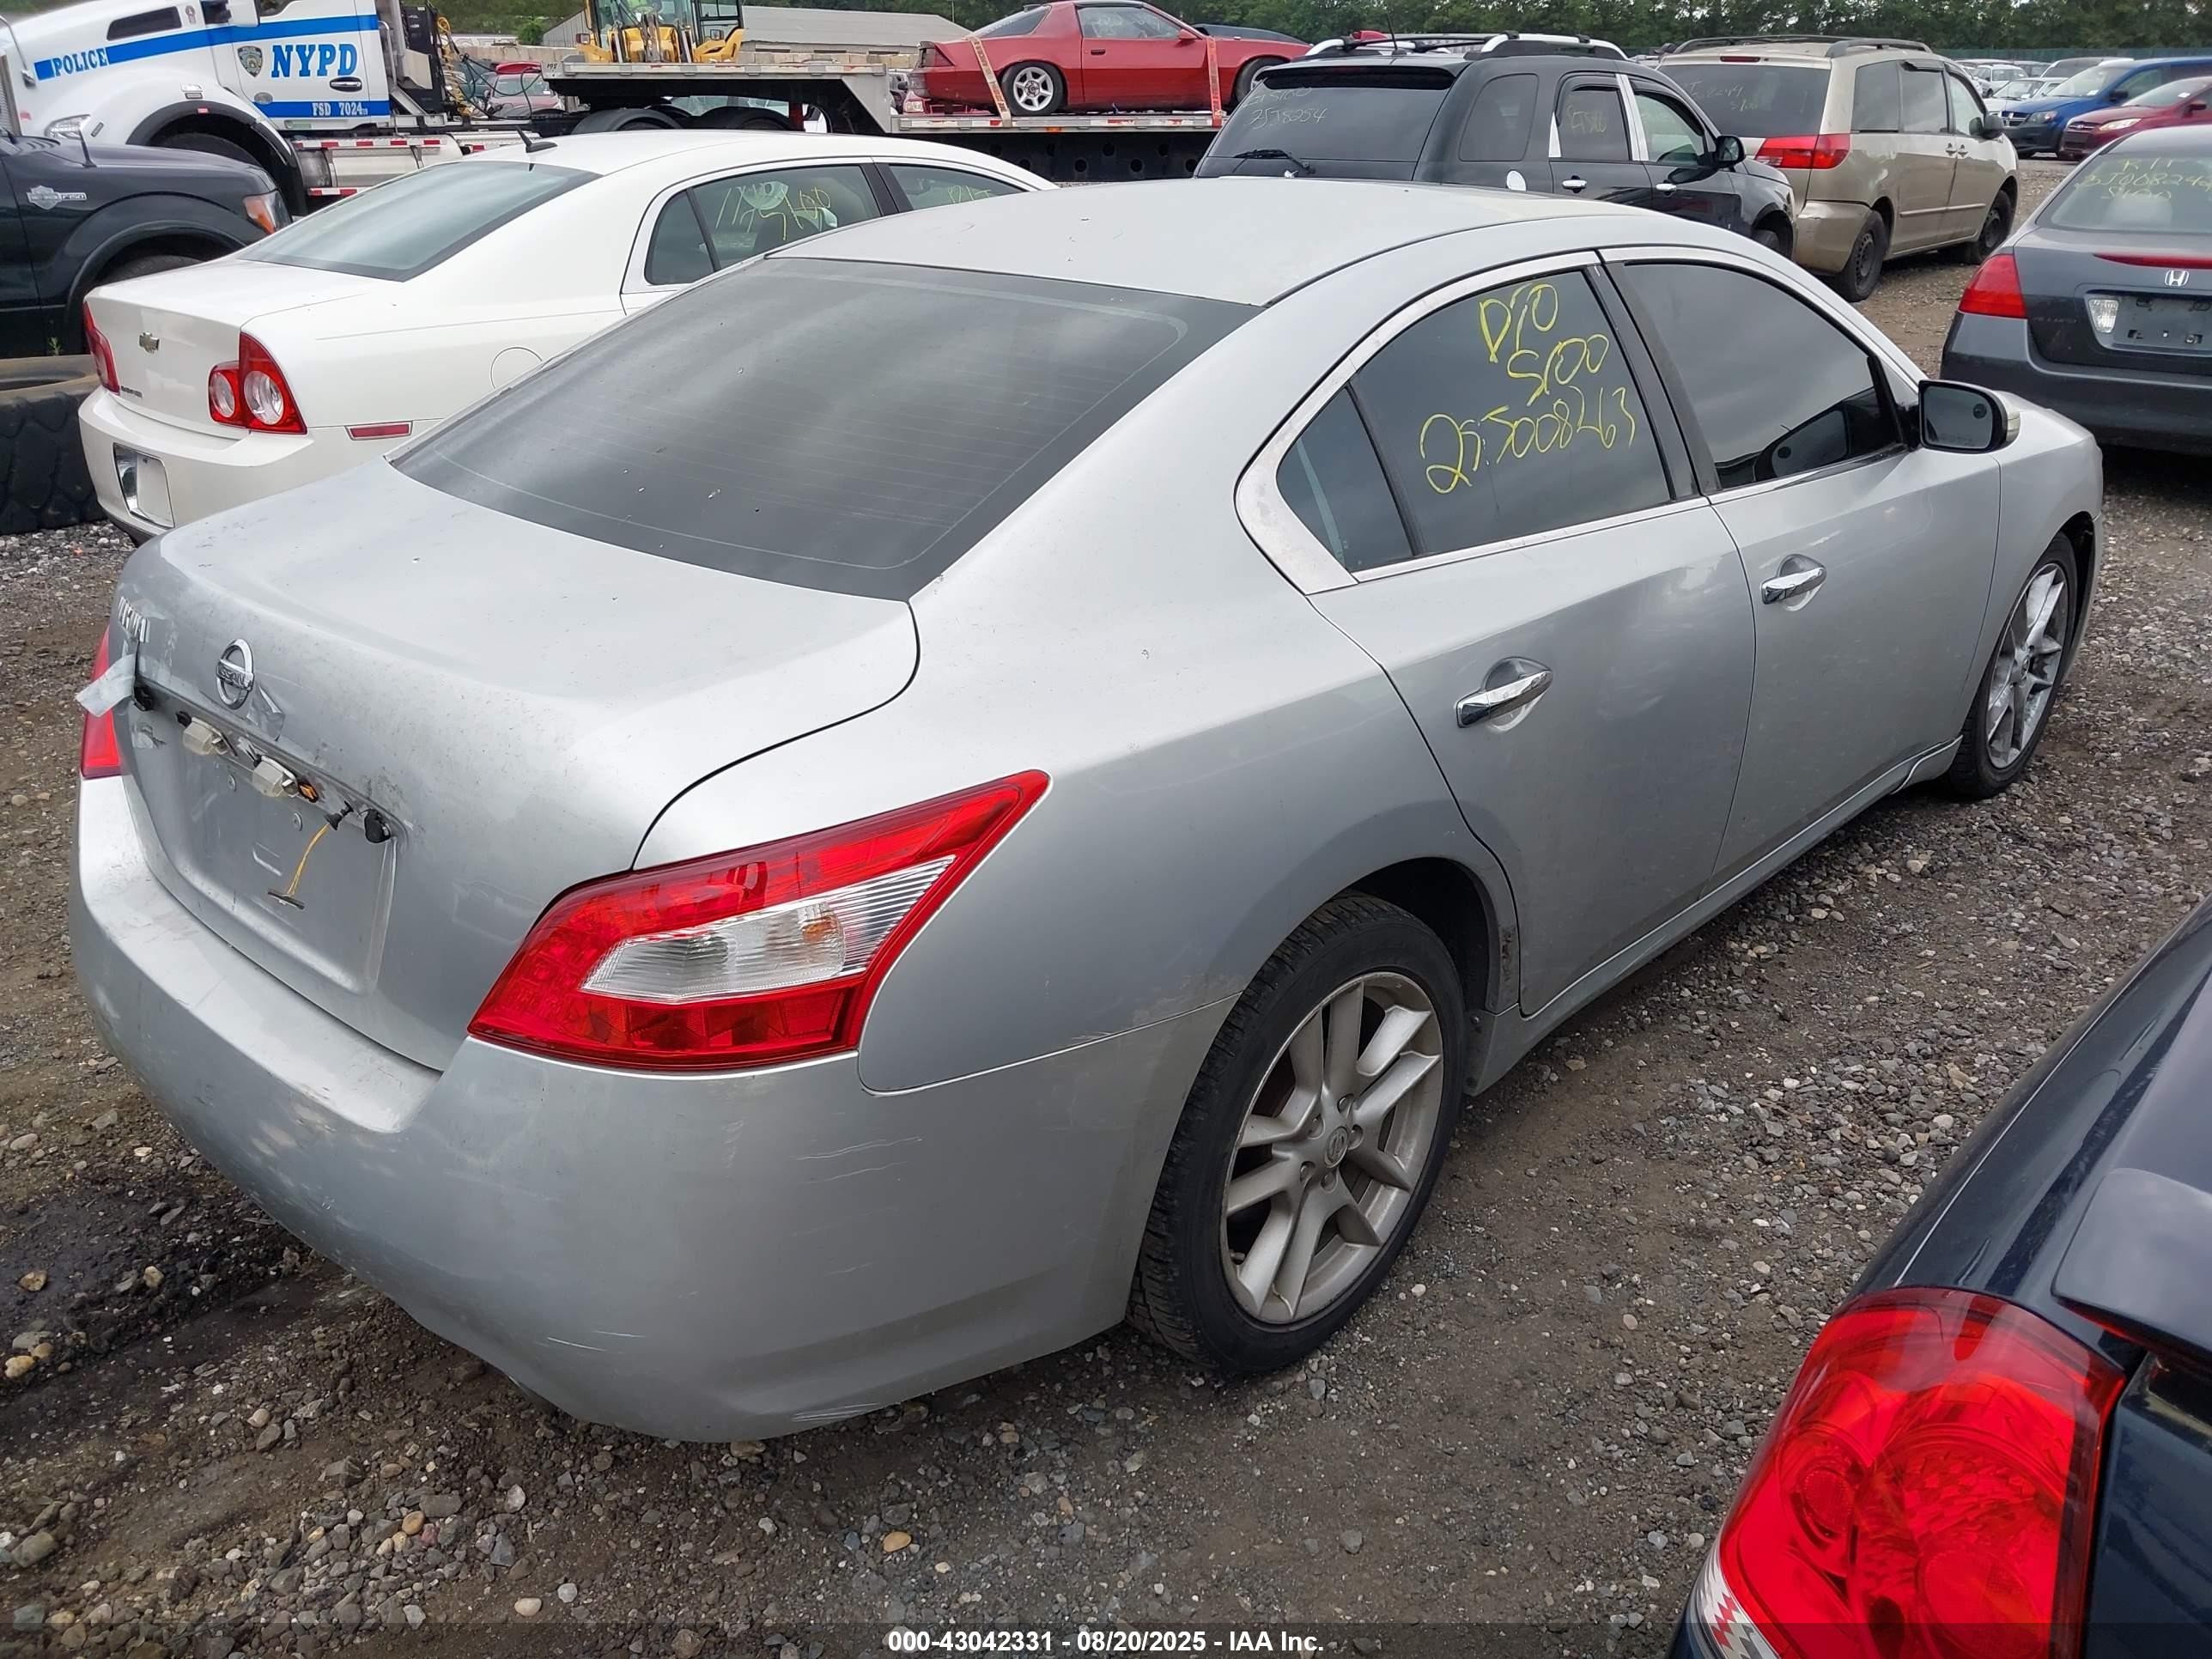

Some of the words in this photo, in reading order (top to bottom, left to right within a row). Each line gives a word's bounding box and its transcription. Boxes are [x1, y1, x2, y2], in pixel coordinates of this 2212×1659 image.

[52, 47, 107, 77] POLICE
[270, 43, 357, 78] NYPD
[312, 102, 331, 117] FSD
[338, 101, 362, 116] 7024
